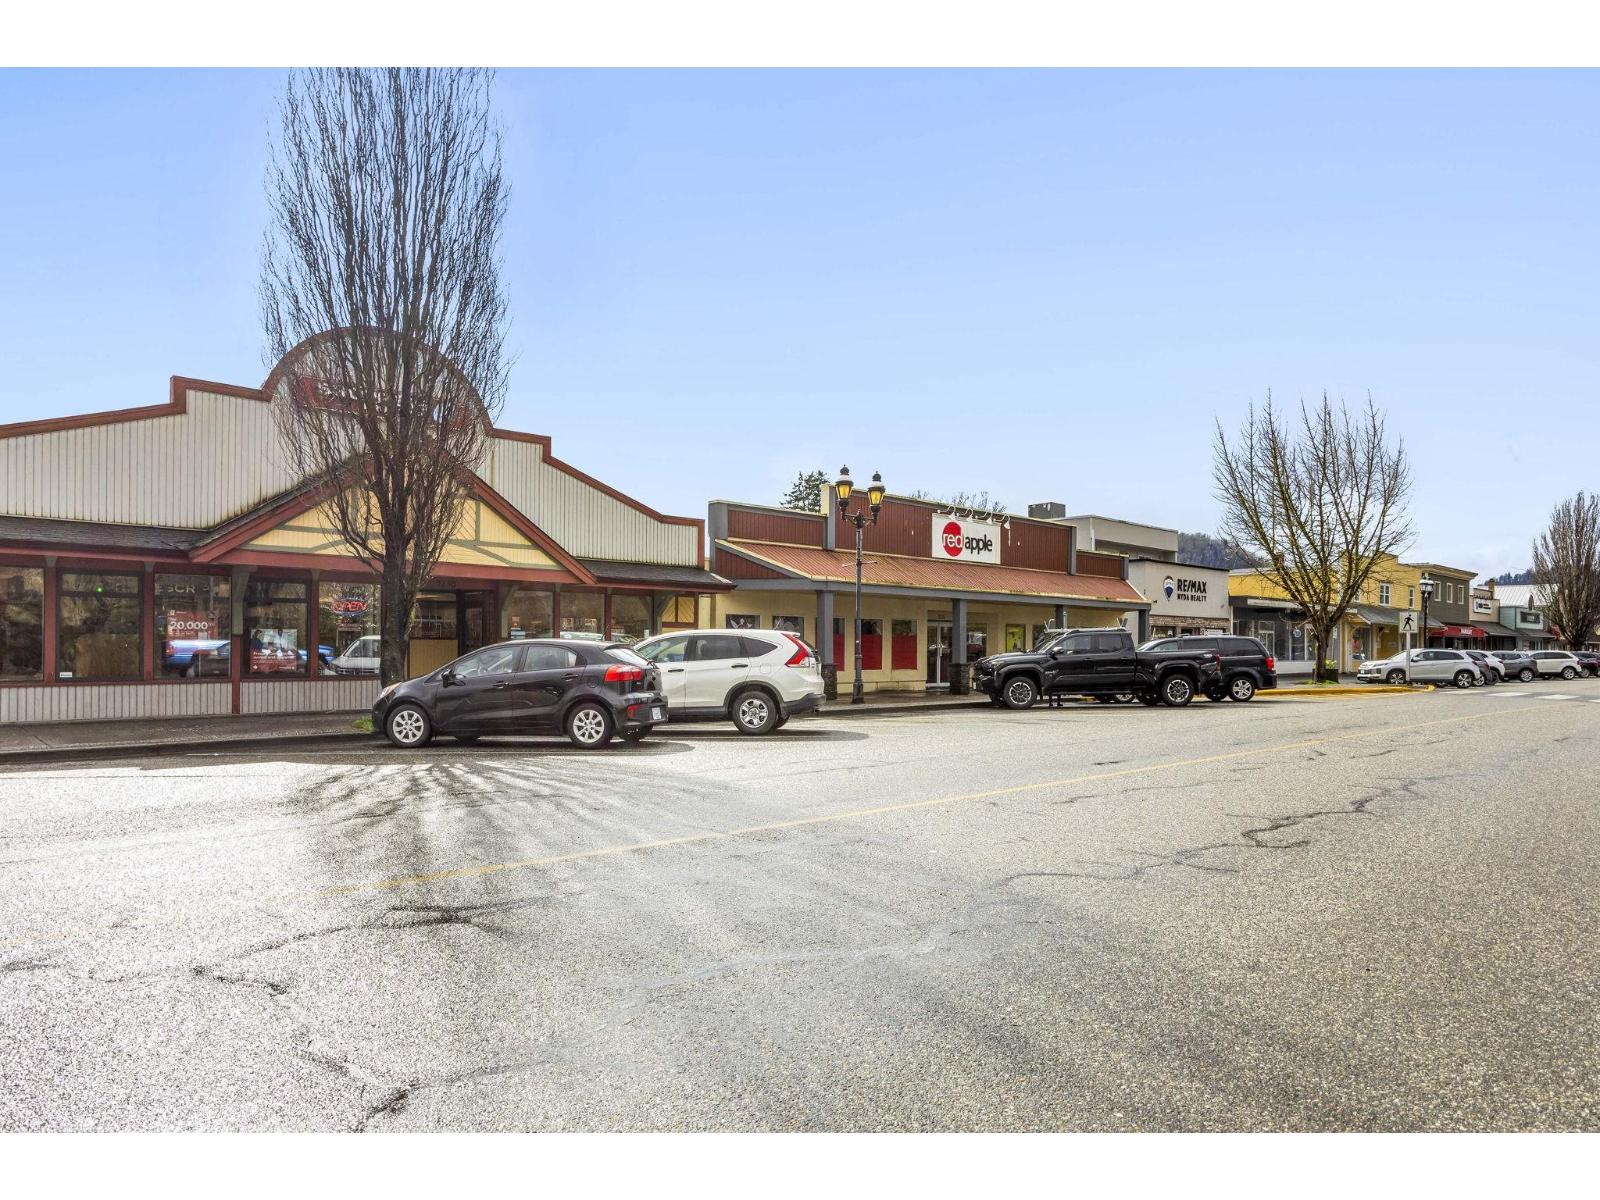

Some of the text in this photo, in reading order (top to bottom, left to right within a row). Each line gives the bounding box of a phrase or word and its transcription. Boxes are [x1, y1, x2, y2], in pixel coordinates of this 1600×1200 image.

[943, 527, 993, 555] red apple
[1177, 578, 1207, 594] RE/MAX
[1190, 594, 1207, 602] REALTY
[170, 621, 209, 630] 20,000
